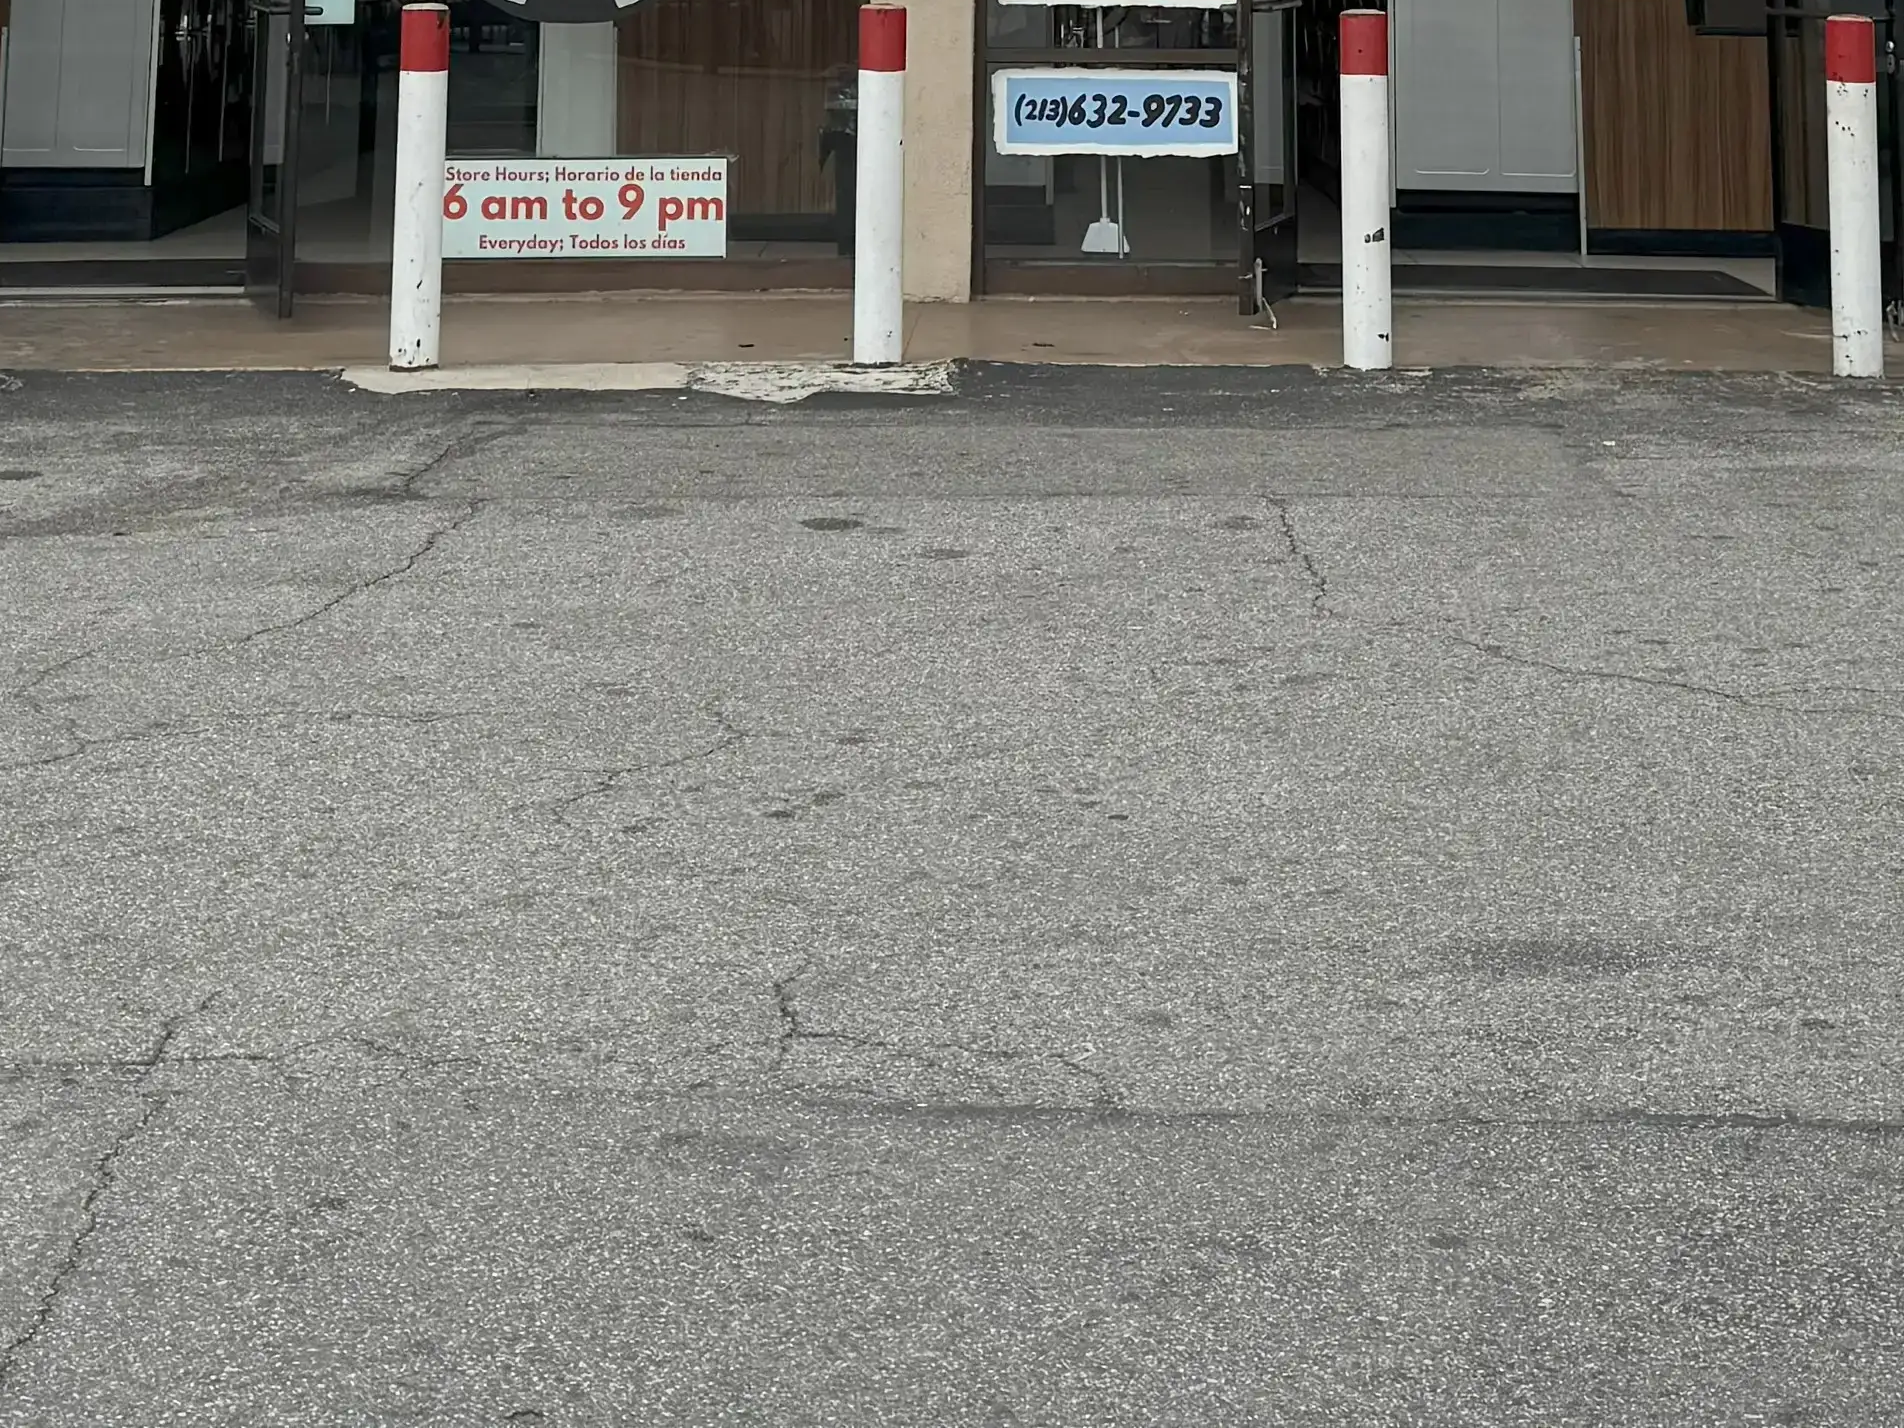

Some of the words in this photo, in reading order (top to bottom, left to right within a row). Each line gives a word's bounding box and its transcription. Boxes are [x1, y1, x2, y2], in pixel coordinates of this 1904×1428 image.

[1014, 93, 1223, 129] (213)632-9733
[445, 166, 490, 181] Store
[495, 167, 550, 183] Hours;
[555, 166, 620, 181] Horario
[624, 166, 645, 181] de
[650, 166, 665, 182] la
[670, 167, 723, 182] tienda
[442, 183, 468, 220] 6
[481, 196, 548, 220] am
[562, 189, 605, 220] to
[617, 183, 646, 220] 9
[658, 196, 724, 231] pm
[479, 234, 564, 254] Everyday;
[569, 234, 619, 249] Todos
[624, 234, 647, 249] los
[651, 232, 686, 250] días
